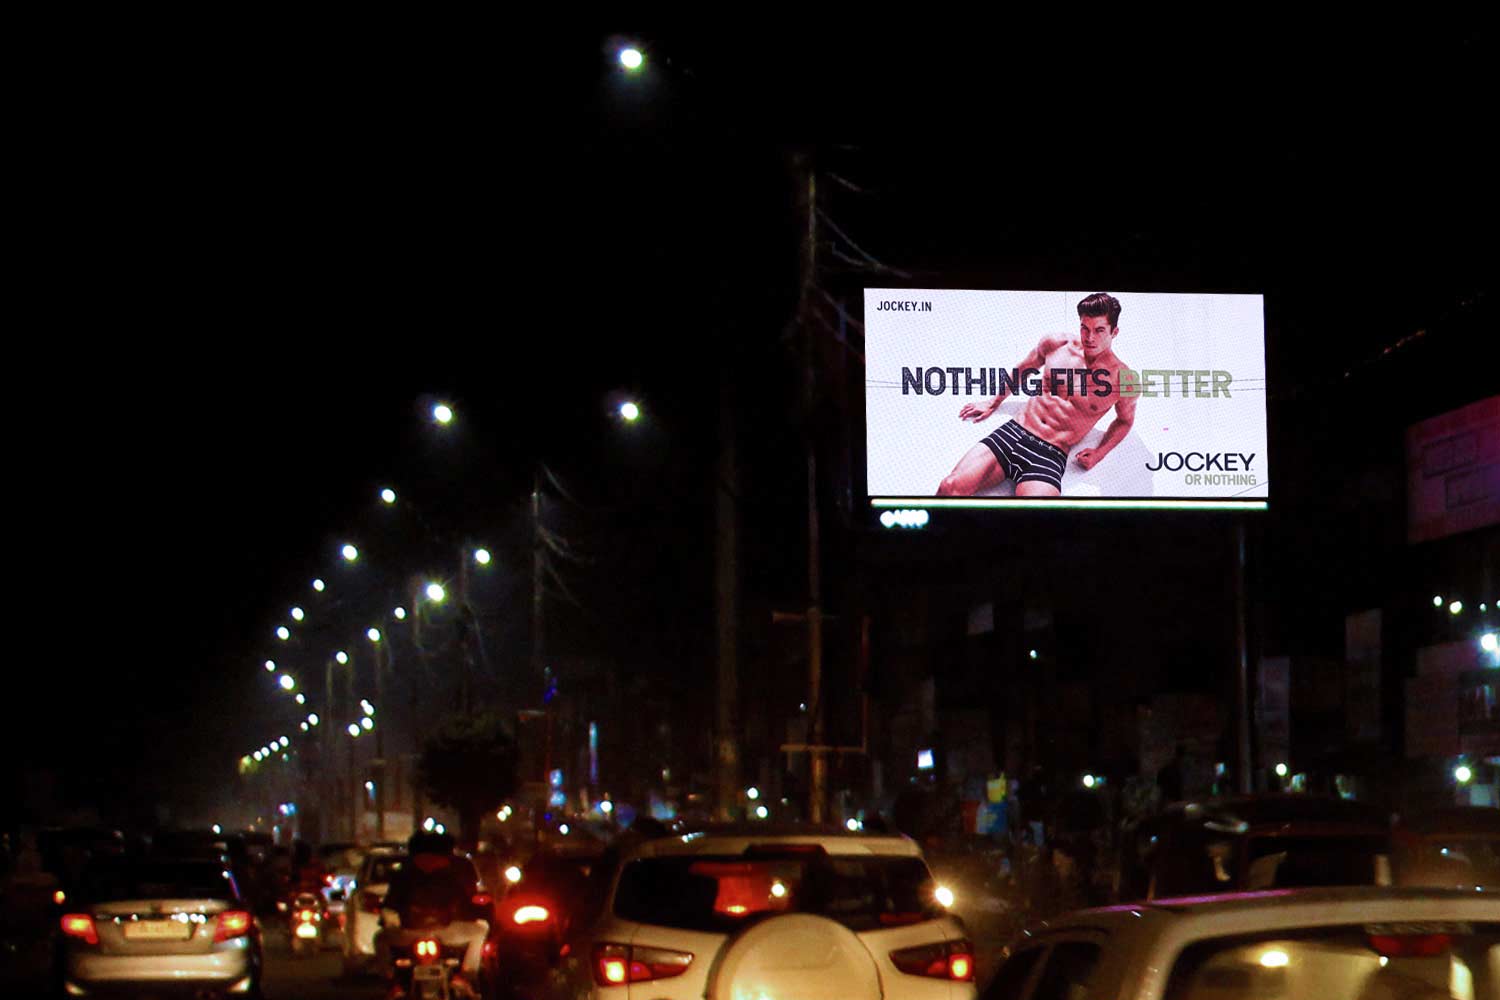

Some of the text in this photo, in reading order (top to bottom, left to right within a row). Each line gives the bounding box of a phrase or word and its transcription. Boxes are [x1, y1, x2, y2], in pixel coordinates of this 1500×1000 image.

[876, 300, 932, 312] JOCKEY.IN
[901, 366, 1233, 398] NOTHING FITS BETTER
[1145, 451, 1256, 472] JOCKEY
[1184, 474, 1257, 486] OR NOTHING
